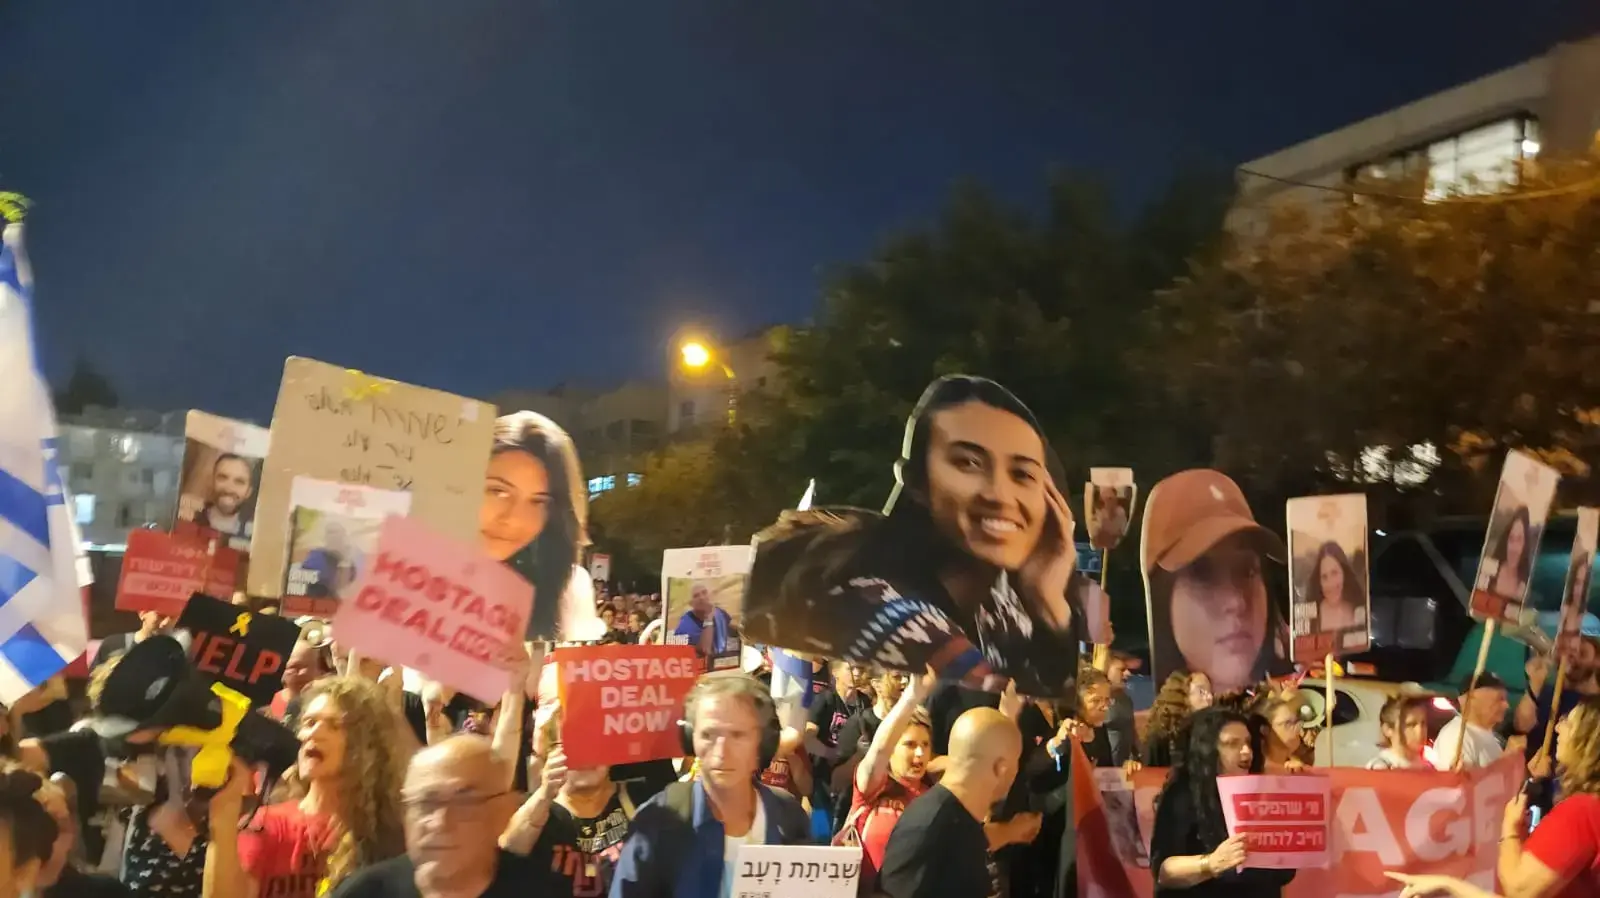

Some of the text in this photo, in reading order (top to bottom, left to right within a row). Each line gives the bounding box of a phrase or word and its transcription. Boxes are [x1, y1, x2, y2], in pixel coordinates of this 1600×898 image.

[374, 551, 522, 636] HOSTAGE
[355, 584, 448, 644] DEAL
[565, 657, 694, 683] HOSTAGE
[601, 684, 675, 709] DEAL
[603, 710, 672, 736] NOW
